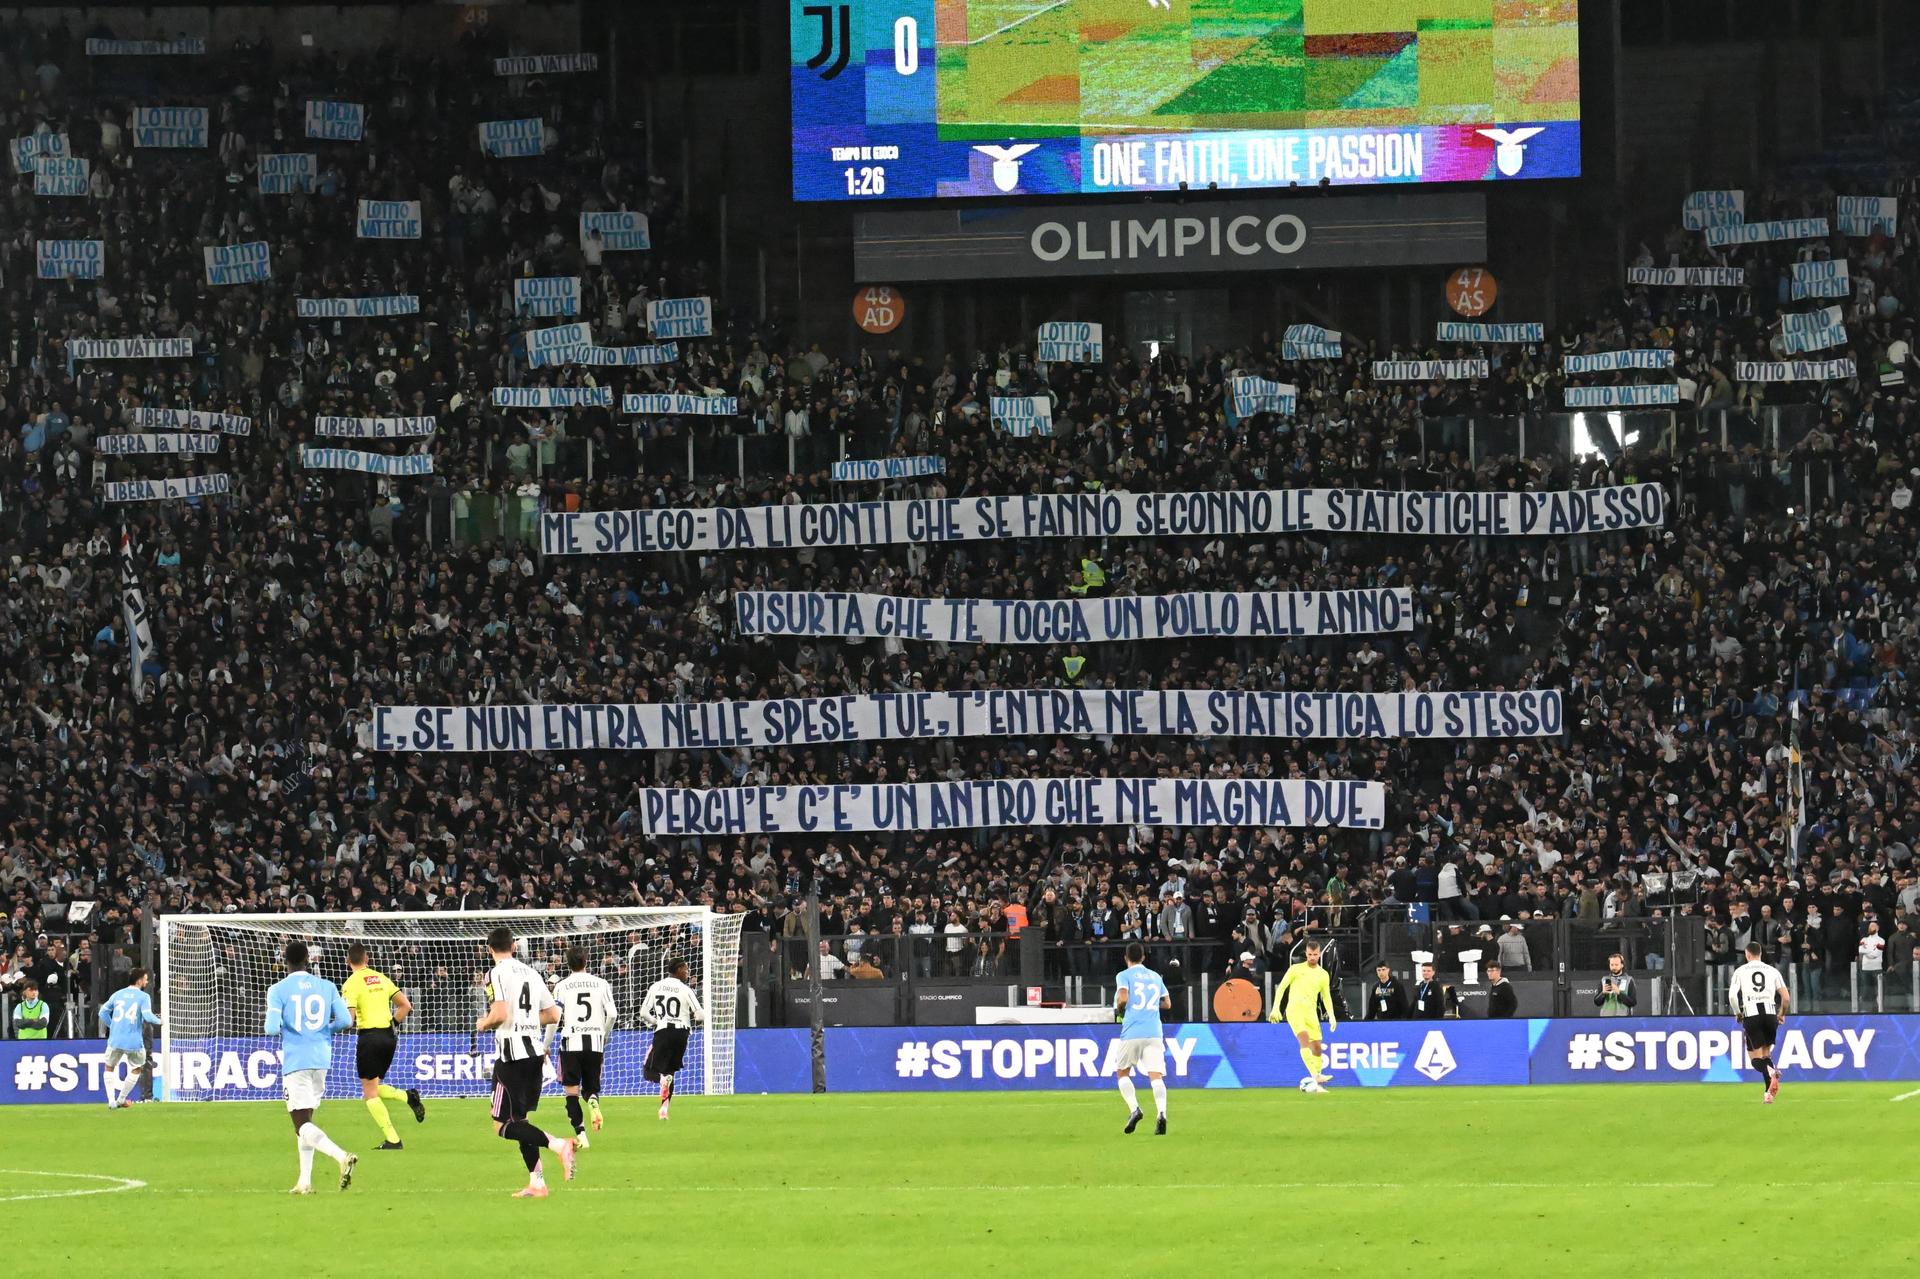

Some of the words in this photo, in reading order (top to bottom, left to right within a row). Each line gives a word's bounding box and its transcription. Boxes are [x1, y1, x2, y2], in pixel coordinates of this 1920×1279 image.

[895, 16, 918, 75] 0
[139, 108, 203, 128] LOTITO
[36, 160, 83, 177] LIBERA
[262, 155, 308, 173] LOTITO
[1093, 142, 1146, 186] ONE
[1155, 135, 1239, 185] FAITH,
[1247, 134, 1299, 180] ONE
[1309, 132, 1423, 177] PASSION
[50, 177, 87, 194] LAZIO
[844, 166, 885, 195] 1:26
[367, 201, 409, 219] LOTITO
[1839, 197, 1880, 216] LOTITO
[361, 219, 419, 237] VATTENE
[585, 214, 633, 229] LOTITO
[1707, 225, 1759, 246] LOTITO
[1765, 218, 1828, 240] VATTENE
[1031, 214, 1307, 262] OLIMPICO
[43, 241, 97, 259] LOTITO
[213, 243, 267, 265] LOTITO
[208, 261, 269, 285] VATTENE
[1457, 269, 1483, 288] 47
[1629, 267, 1675, 284] LOTITO
[1685, 268, 1742, 285] VATTENE
[521, 279, 572, 297] LOTITO
[865, 288, 891, 305] 48
[299, 299, 348, 315] LOTITO
[355, 297, 419, 315] VATTENE
[656, 300, 705, 318] LOTITO
[1456, 290, 1485, 310] AS
[862, 307, 894, 326] AD
[1784, 310, 1830, 335] LOTITO
[535, 326, 582, 347] LOTITO
[651, 318, 708, 337] VATTENE
[1041, 323, 1090, 341] LOTITO
[1439, 323, 1481, 340] LOTITO
[1485, 323, 1543, 342] VATTENE
[124, 338, 190, 357] VATTENE
[1785, 325, 1847, 354] VATTENE
[576, 345, 616, 364] LOTITO
[621, 343, 679, 364] VATTENE
[1566, 353, 1611, 373] LOTITO
[1615, 350, 1673, 369] VATTENE
[1374, 361, 1421, 379] LOTITO
[1426, 360, 1488, 379] VATTENE
[1738, 362, 1786, 380] LOTITO
[1792, 359, 1857, 380] VATTENE
[493, 388, 540, 406] LOTITO
[550, 386, 611, 406] VATTENE
[624, 395, 670, 413] LOTITO
[676, 395, 738, 415] VATTENE
[1566, 387, 1611, 406] LOTITO
[1617, 384, 1678, 404] VATTENE
[991, 397, 1034, 417] LOTITO
[134, 408, 180, 427] LIBERA
[209, 413, 250, 434] LAZIO
[317, 417, 365, 436] LIBERA
[372, 417, 387, 436] la
[394, 418, 435, 435] LAZIO
[98, 435, 148, 453] LIBERA
[178, 433, 219, 452] LAZIO
[304, 450, 360, 468] LOTITO
[366, 453, 432, 475] VATTENE
[832, 460, 879, 480] LOTITO
[885, 456, 945, 478] VATTENE
[105, 481, 156, 501] LIBERA
[186, 474, 227, 498] LAZIO
[544, 513, 581, 554] ME
[716, 507, 755, 547] DA
[766, 505, 791, 547] LI
[801, 502, 892, 546] CONTI
[907, 499, 964, 541] CHE
[976, 496, 1012, 539] SE
[1023, 494, 1122, 536] FANNO
[1136, 491, 1272, 535] SECONNO
[1282, 490, 1313, 530] LE
[1328, 489, 1511, 535] STATISTICHE
[1520, 483, 1660, 535] D'ADESSO
[738, 592, 864, 634] RISURTA
[876, 597, 933, 639] CHE
[944, 597, 982, 641] TE
[993, 599, 1091, 642] TOCCA
[1103, 596, 1143, 640] UN
[1155, 592, 1239, 637] POLLO
[466, 705, 532, 751] NUN
[543, 704, 648, 750] ENTRA
[661, 702, 753, 747] NELLE
[763, 696, 859, 743] SPESE
[1106, 690, 1148, 734] NE
[1159, 691, 1198, 734] LA
[1208, 690, 1387, 737] STATISTICA
[1398, 692, 1434, 737] LO
[1445, 689, 1561, 737] STESSO
[650, 785, 787, 833] PERCH'E'
[798, 784, 860, 832] C'E'
[872, 783, 919, 830] UN
[931, 780, 1035, 829] ANTRO
[1046, 779, 1103, 826] CHE
[1116, 779, 1162, 825] NE
[1175, 780, 1291, 826] MAGNA
[1304, 782, 1380, 827] DUE.
[1752, 971, 1765, 992] 9
[519, 982, 532, 1018] 4
[1132, 982, 1160, 1010] 32
[113, 1000, 138, 1024] 34
[291, 994, 325, 1031] 19
[577, 992, 592, 1022] 5
[655, 995, 681, 1020] 30
